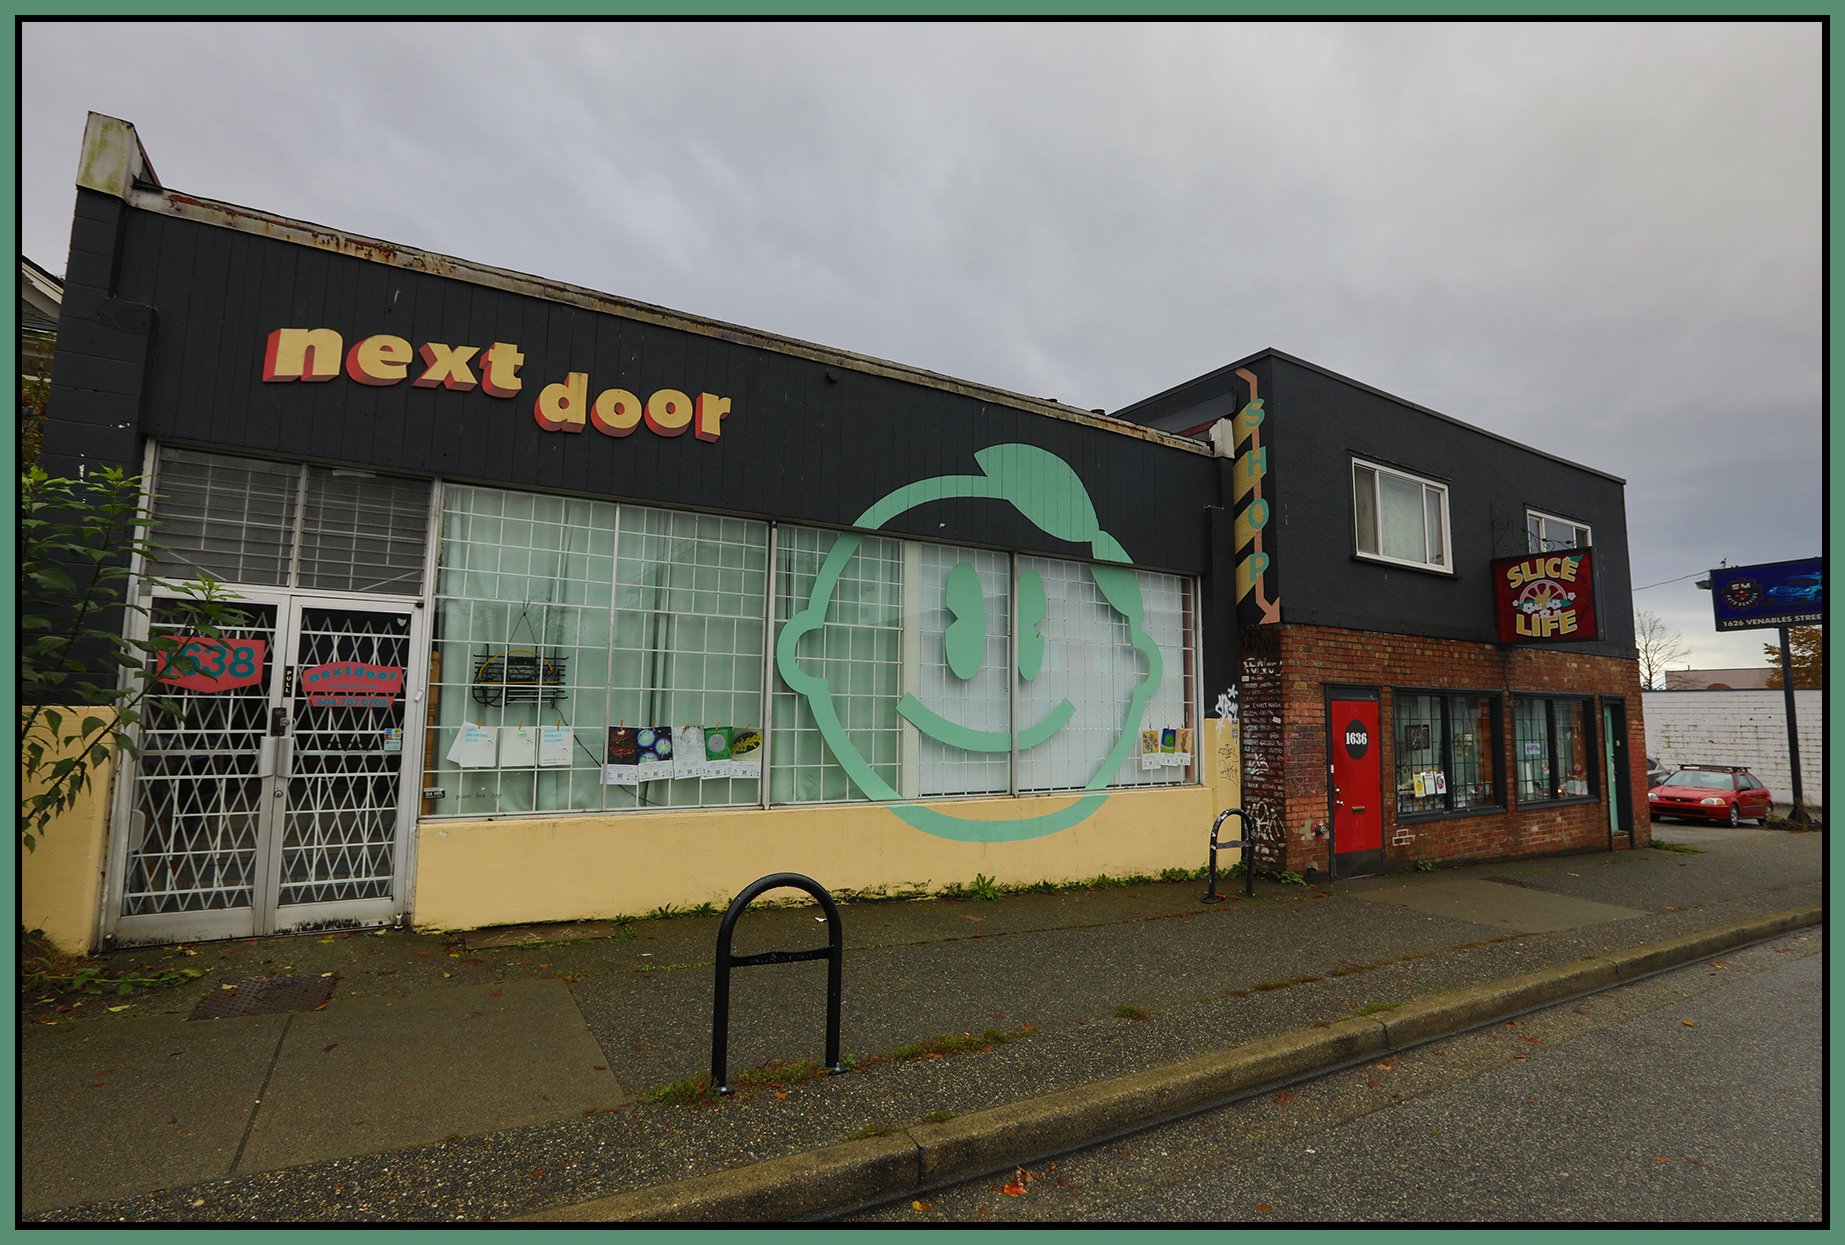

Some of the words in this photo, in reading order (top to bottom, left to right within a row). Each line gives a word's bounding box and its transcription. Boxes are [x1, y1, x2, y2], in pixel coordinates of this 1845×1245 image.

[262, 327, 525, 398] next
[534, 371, 731, 443] door
[1244, 398, 1269, 582] SHOP
[1507, 557, 1579, 588] SLICE
[1731, 582, 1751, 590] SM
[1516, 609, 1578, 637] LIFE
[1745, 615, 1792, 626] VENABLES
[285, 670, 293, 694] PULL
[1345, 732, 1368, 745] 1636
